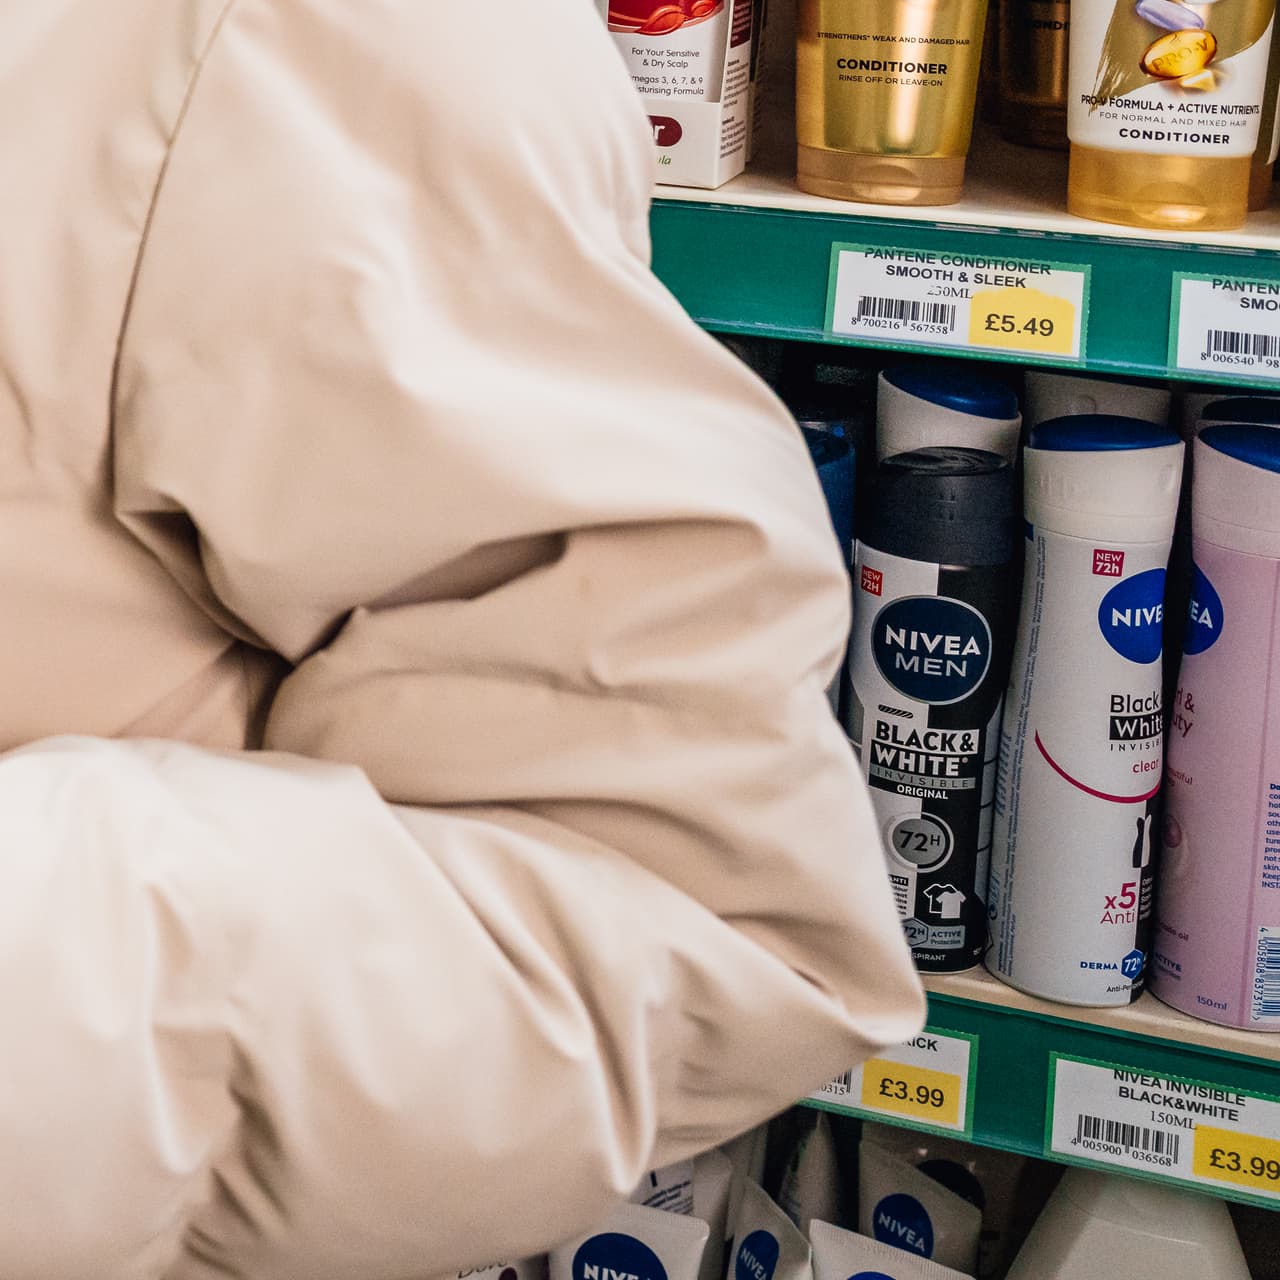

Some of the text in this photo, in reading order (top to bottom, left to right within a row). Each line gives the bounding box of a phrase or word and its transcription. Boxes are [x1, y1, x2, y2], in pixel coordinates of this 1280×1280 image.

[836, 58, 948, 74] CONDITIONER
[1081, 94, 1260, 115] PRO-V FORMULA ACTIVE NUTRIENTS
[1119, 128, 1230, 145] CONDITIONER
[864, 247, 1051, 275] PANTENE CONDITIONER
[885, 264, 1027, 288] SMOOTH & SLEEK
[1240, 297, 1280, 311] SMO
[984, 313, 1054, 337] £5.49
[1095, 561, 1119, 574] 72h
[1096, 552, 1122, 562] NEW
[863, 569, 881, 581] NEW
[885, 624, 981, 656] NIVEA
[895, 651, 968, 678] MEN
[1110, 690, 1160, 713] Black
[874, 743, 961, 777] WHITE
[1132, 759, 1159, 774] clear
[876, 768, 970, 788] INVISIBLE
[896, 784, 949, 800] ORIGINAL
[1104, 881, 1137, 910] x5
[1100, 909, 1136, 925] Anti
[1080, 961, 1118, 970] DERMA
[879, 1077, 944, 1108] £3.99
[1113, 1069, 1246, 1107] NIVEA INVISIBLE
[1118, 1086, 1239, 1122] BLACK&WHITE
[1150, 1110, 1198, 1130] 150ML
[1210, 1148, 1280, 1180] £3.99
[878, 1211, 926, 1253] NIVEA
